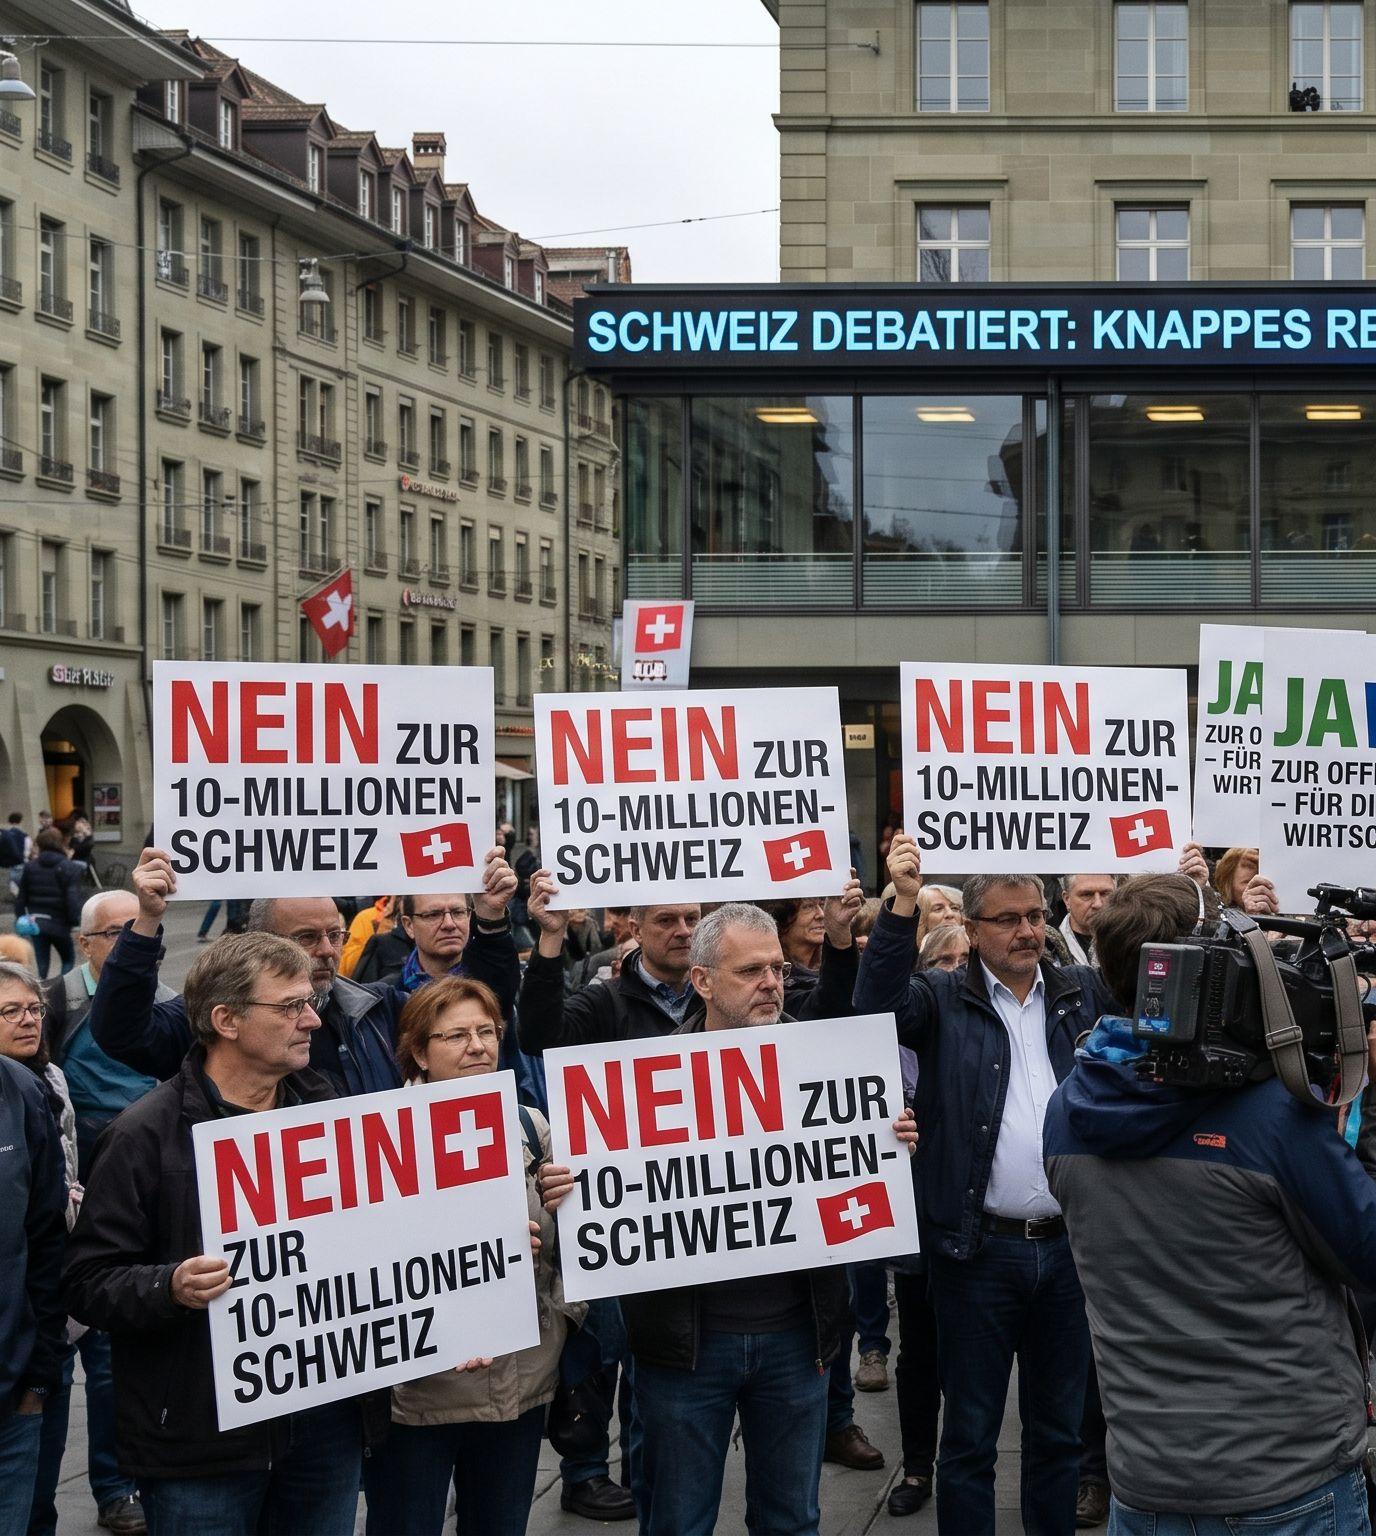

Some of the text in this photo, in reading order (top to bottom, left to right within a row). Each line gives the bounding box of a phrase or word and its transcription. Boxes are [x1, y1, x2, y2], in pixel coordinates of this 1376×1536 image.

[588, 311, 798, 352] SCHWEIZ
[813, 310, 1075, 350] DEBATIERT:
[1094, 309, 1311, 349] KNAPPES
[1207, 660, 1263, 715] JA
[1273, 677, 1357, 748] JA
[172, 681, 479, 765] NEIN ZUR
[916, 679, 1176, 756] NEIN ZUR
[1205, 725, 1244, 744] ZUR
[551, 707, 830, 784] NEIN ZUR
[1223, 747, 1261, 770] FÜR
[171, 777, 480, 817] 10-MILLIONEN-
[917, 765, 1178, 801] 10-MILLIONEN-
[1271, 760, 1318, 784] ZUR
[555, 790, 834, 833] 10-MILLIONEN-
[1295, 788, 1342, 816] FÜR
[170, 828, 377, 874] SCHWEIZ
[918, 811, 1090, 850] SCHWEIZ
[557, 839, 743, 885] SCHWEIZ
[564, 1044, 889, 1155] NEIN ZUR
[214, 1108, 418, 1233] NEIN
[574, 1134, 896, 1211] 10-MILLIONEN-
[577, 1197, 796, 1270] SCHWEIZ
[228, 1235, 521, 1343] 10-MILLIONEN-
[233, 1307, 437, 1403] SCHWEIZ
